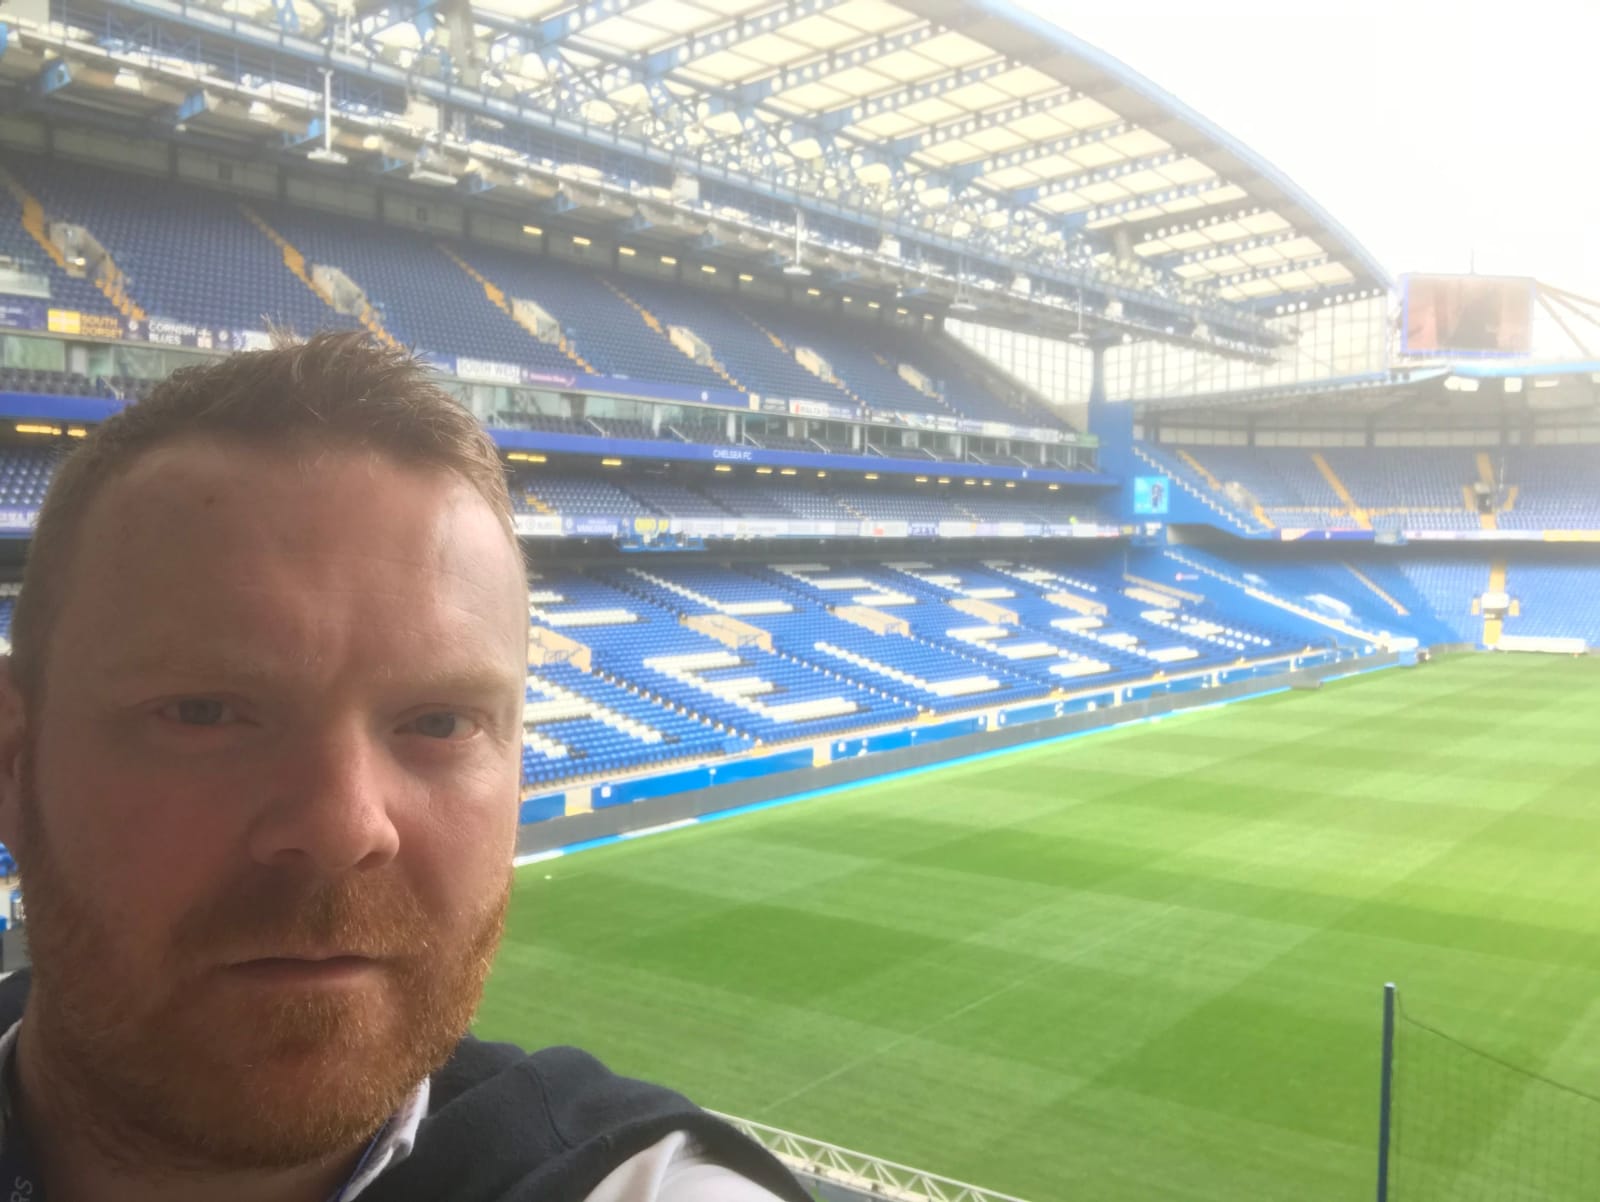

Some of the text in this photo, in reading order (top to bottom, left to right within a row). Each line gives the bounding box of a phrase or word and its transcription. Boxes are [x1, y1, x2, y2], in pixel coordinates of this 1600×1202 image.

[81, 314, 118, 328] SOUTH
[148, 320, 196, 336] CORNISH
[148, 333, 182, 346] BLUES
[712, 448, 753, 461] CHELSEA FC
